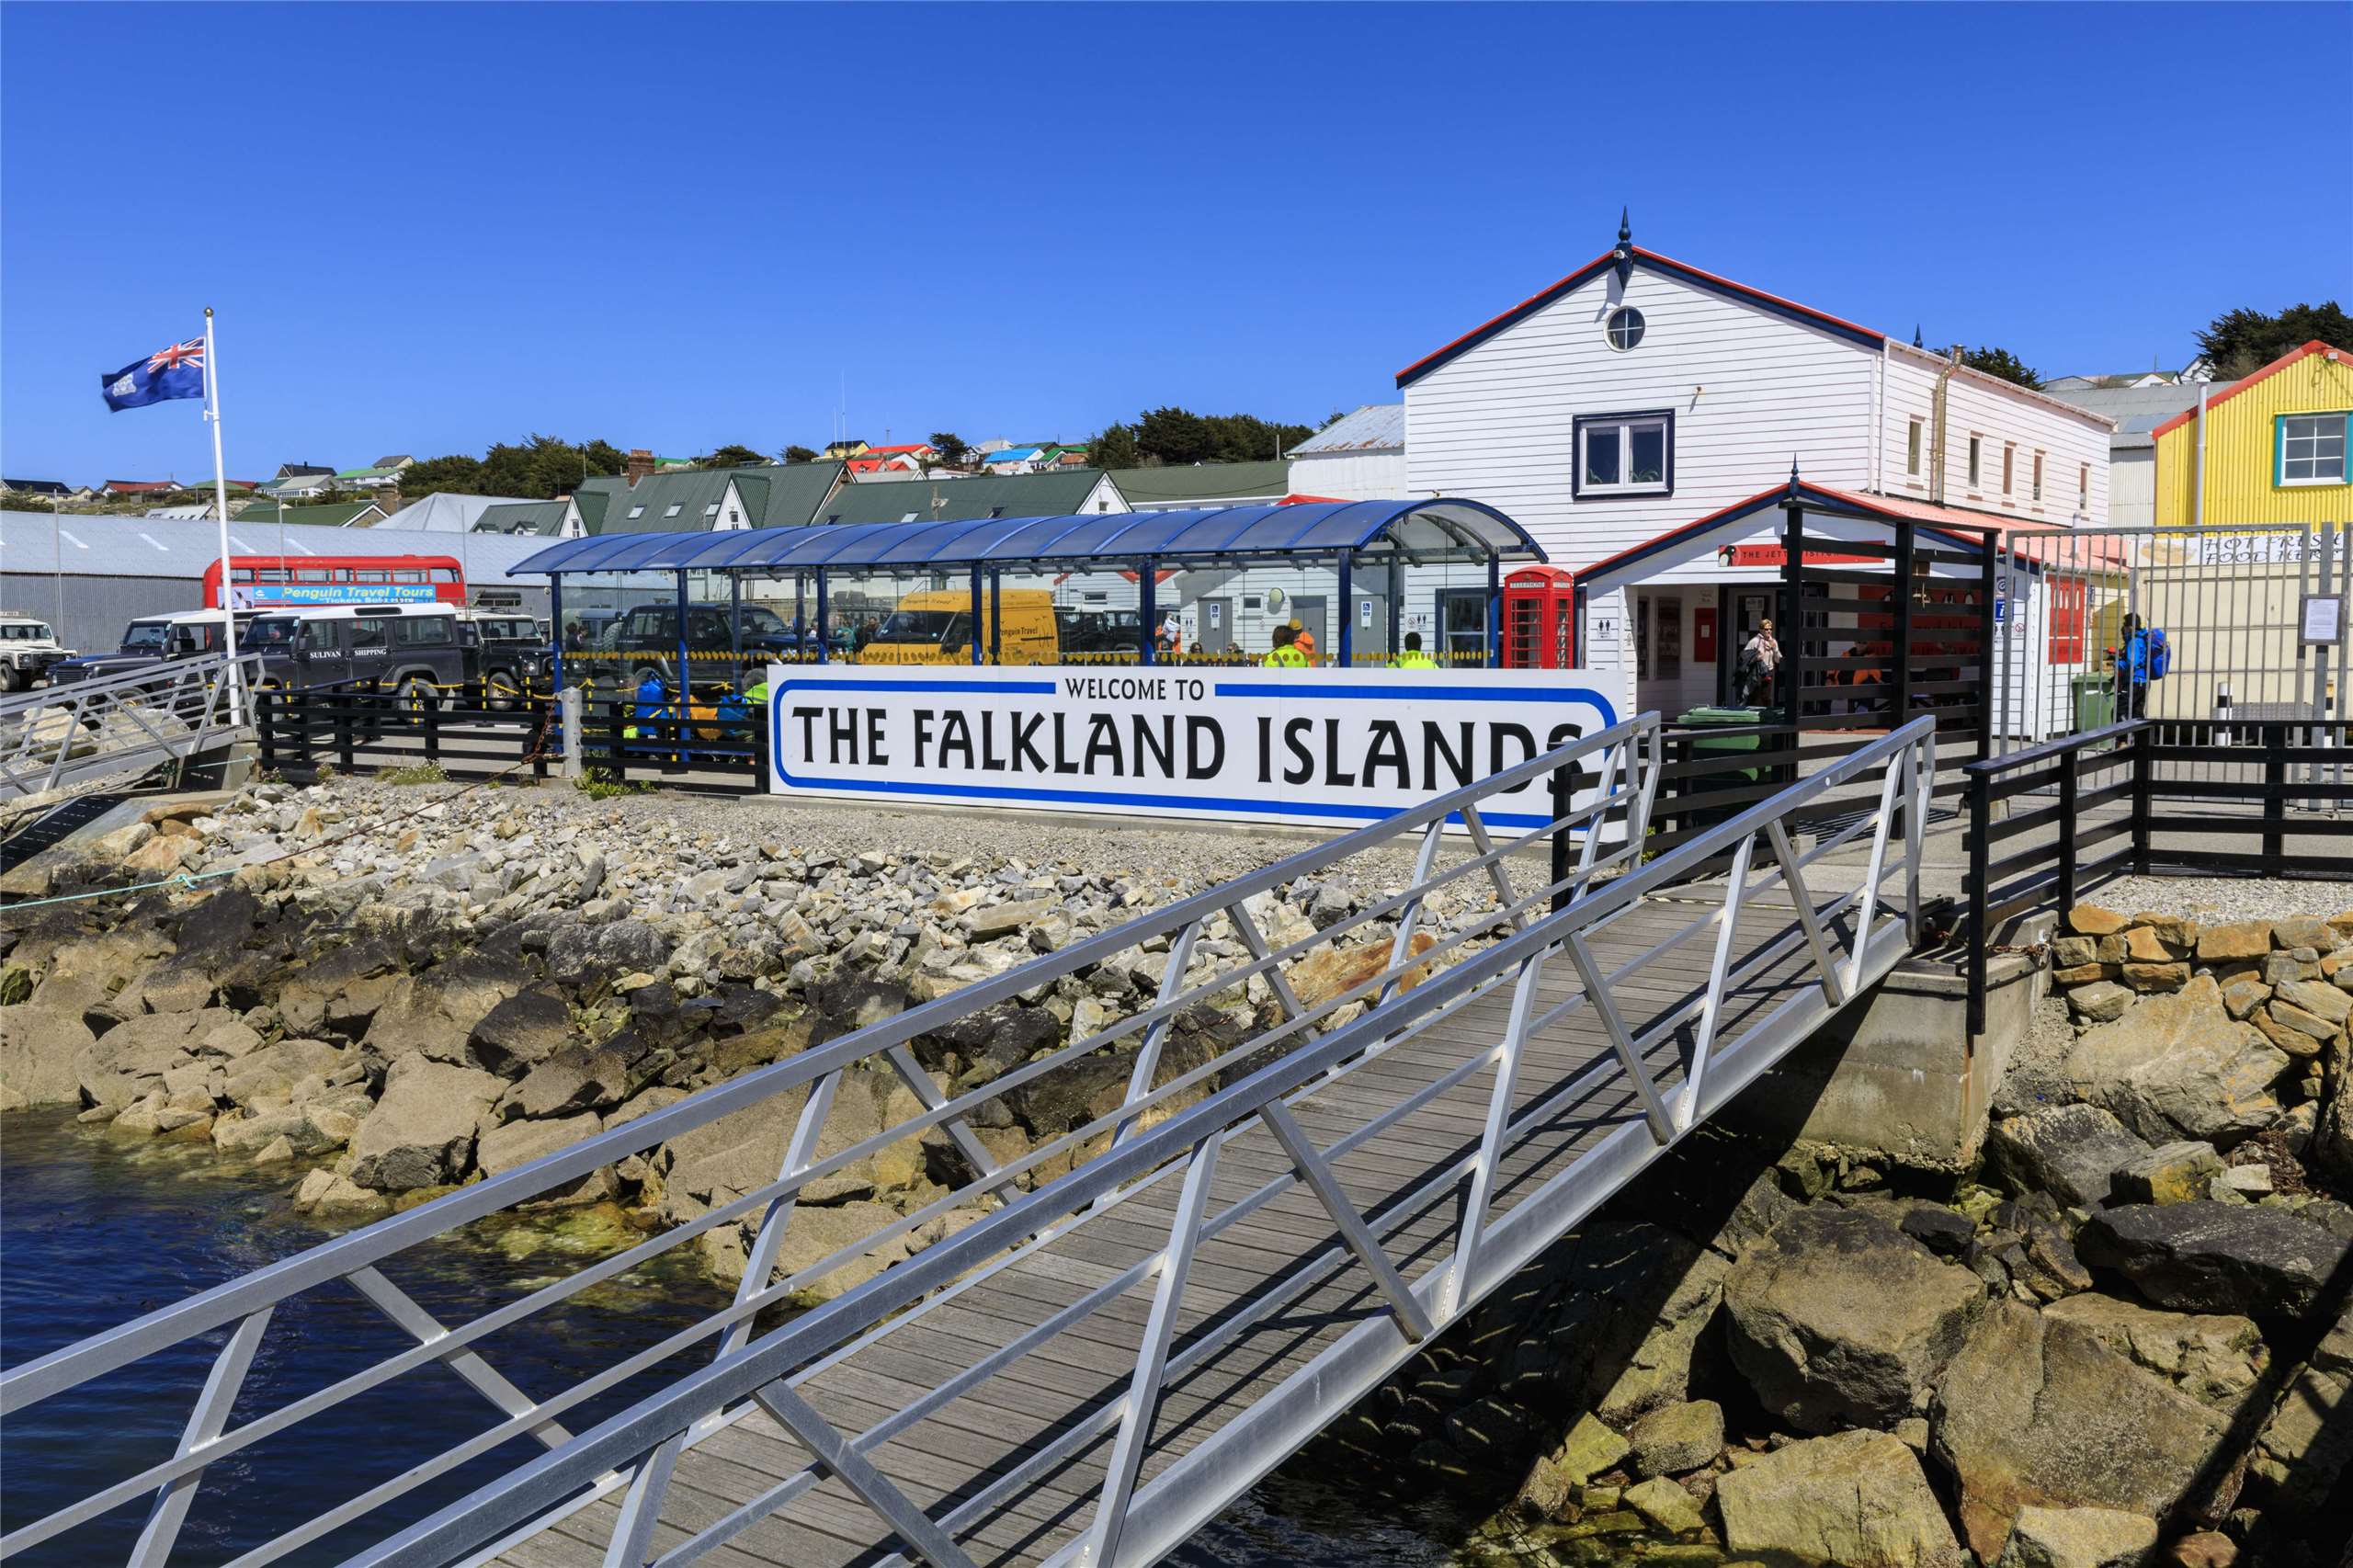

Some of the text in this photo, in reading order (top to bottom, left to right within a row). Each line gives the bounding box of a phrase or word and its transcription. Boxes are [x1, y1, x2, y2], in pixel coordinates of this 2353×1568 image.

[2205, 537, 2259, 551] HOT
[1743, 551, 1760, 559] THE
[2206, 551, 2269, 564] FOOD
[283, 586, 433, 598] Penguin Travel Tours
[1020, 626, 1038, 635] Travel
[310, 648, 387, 659] SULIVAN SHIPPING
[1065, 677, 1204, 700] WELCOME TO
[791, 707, 1583, 796] THE FALKLAND ISLANDS
